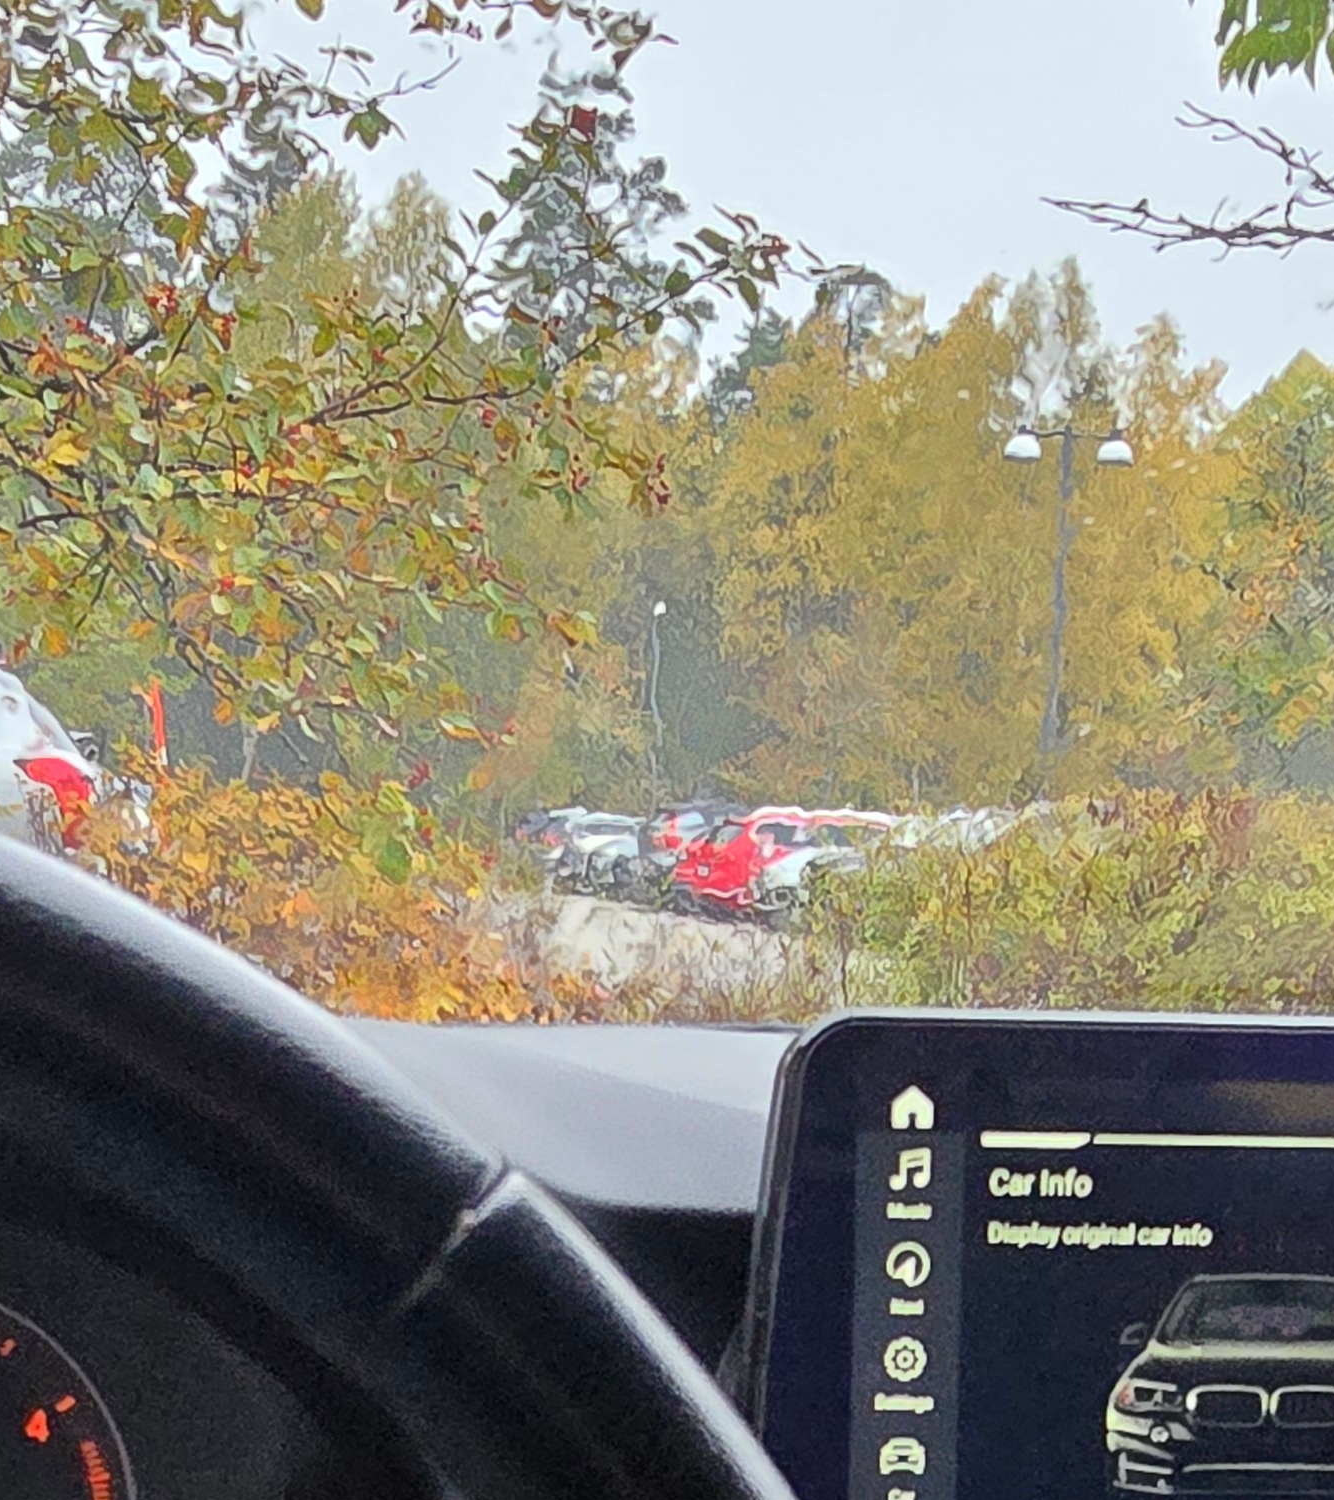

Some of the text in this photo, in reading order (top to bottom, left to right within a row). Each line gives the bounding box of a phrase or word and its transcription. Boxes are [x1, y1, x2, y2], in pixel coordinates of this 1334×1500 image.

[989, 1167, 1093, 1197] Car Info
[988, 1221, 1213, 1249] Display original car info
[25, 1409, 49, 1442] 4
